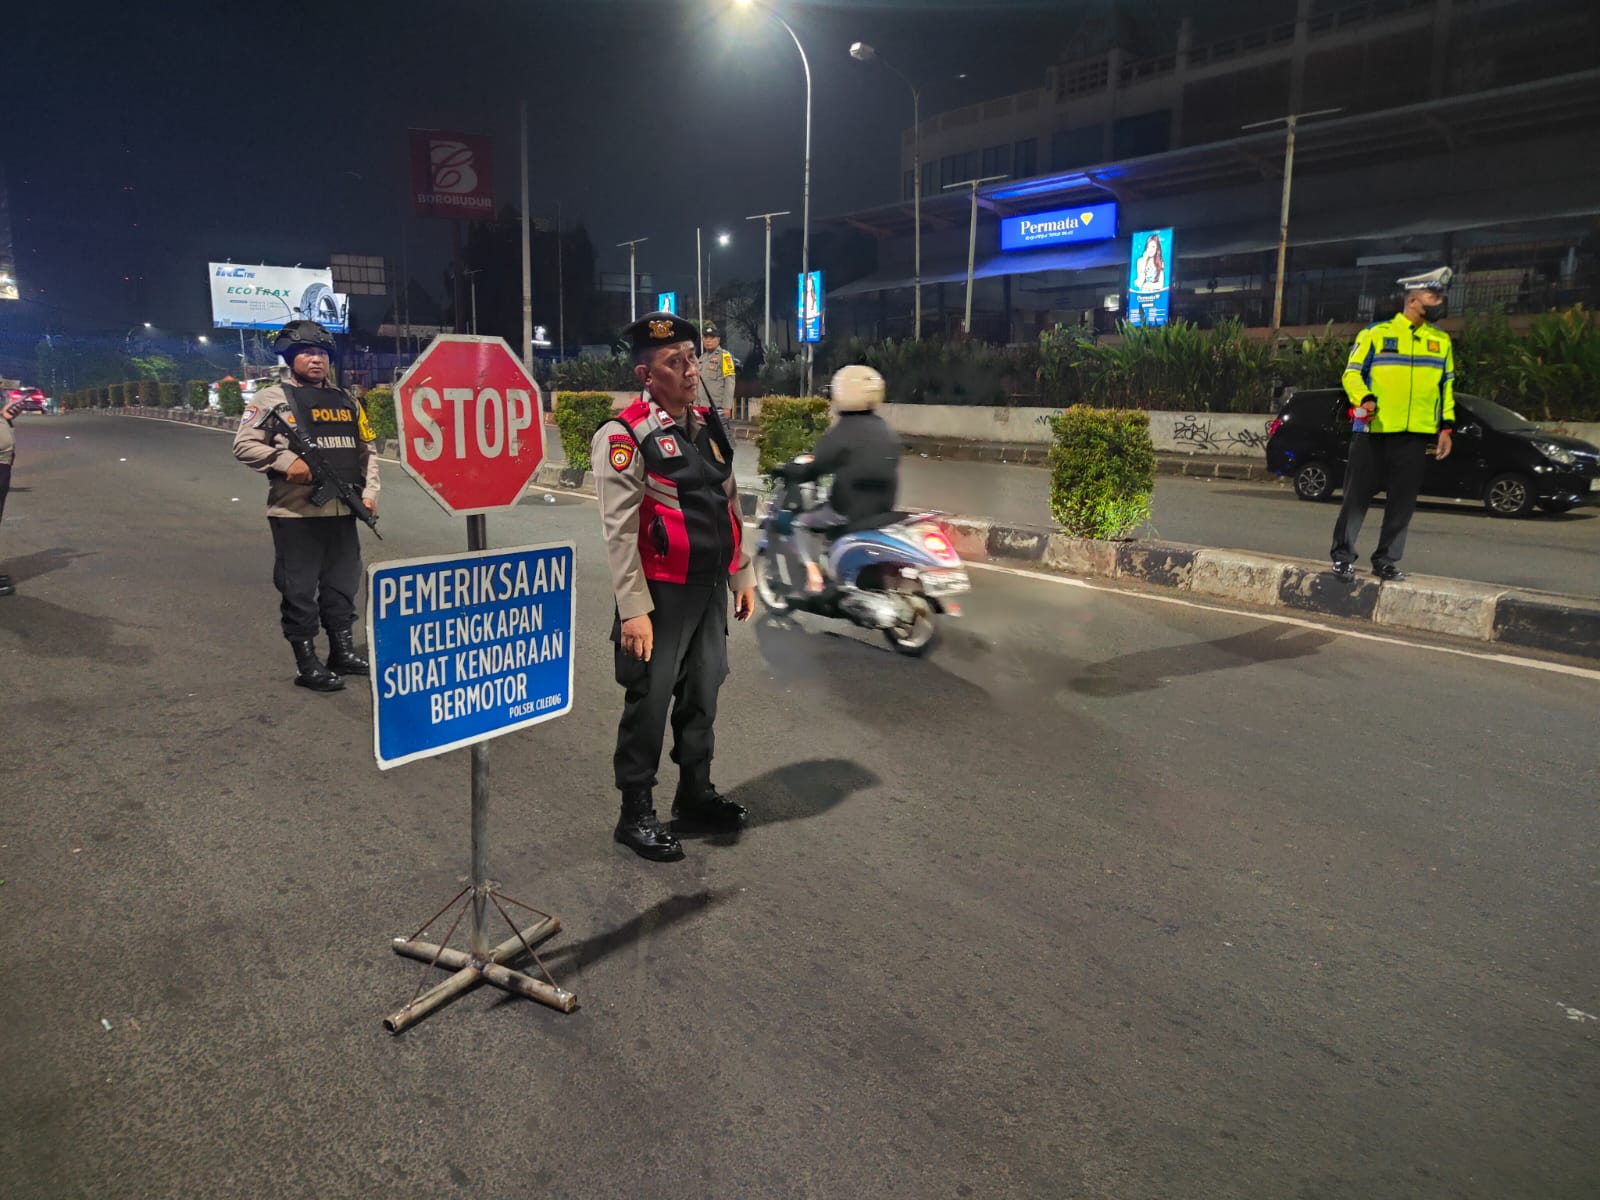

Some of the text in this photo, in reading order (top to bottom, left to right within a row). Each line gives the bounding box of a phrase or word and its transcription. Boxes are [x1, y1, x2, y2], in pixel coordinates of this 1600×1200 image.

[417, 193, 492, 208] BOROBUDUR
[1020, 216, 1079, 235] Permata
[311, 408, 352, 422] POLISI
[411, 386, 532, 462] STOP
[317, 436, 356, 449] SABHARA
[378, 555, 567, 620] PEMERIKSAAN
[409, 603, 543, 657] KELENGKAPAN
[383, 631, 564, 700] SURAT KENDARAAN
[430, 672, 528, 726] BERMOTOR
[509, 693, 562, 719] POLSEK CILEDUG
